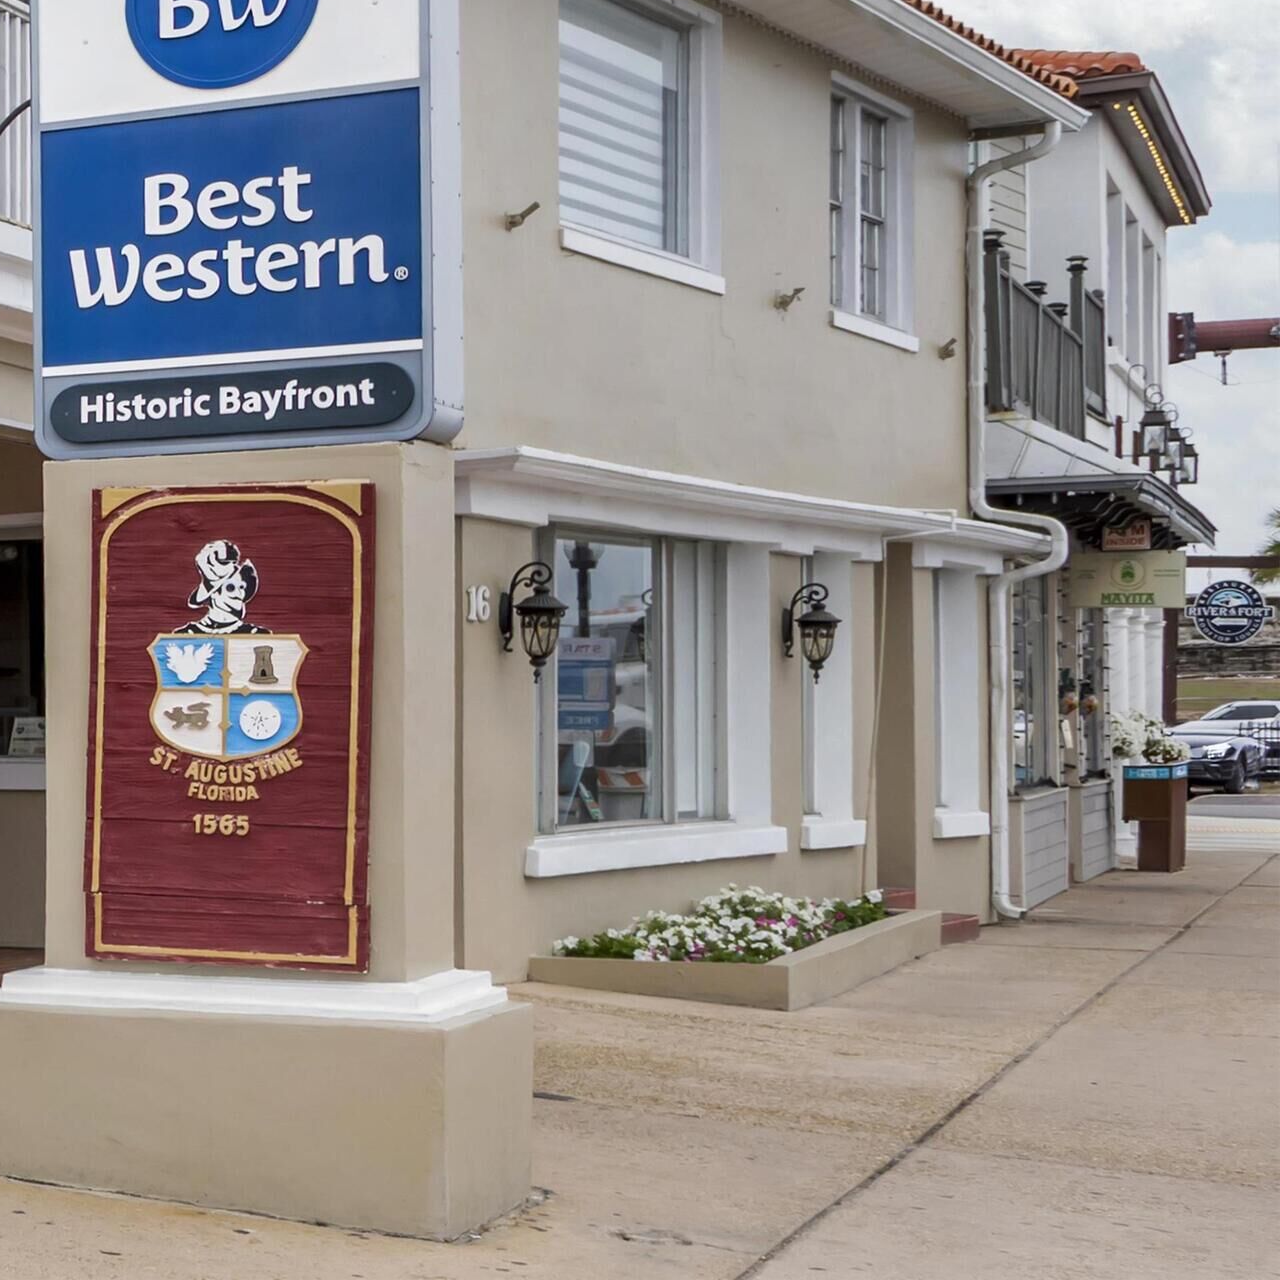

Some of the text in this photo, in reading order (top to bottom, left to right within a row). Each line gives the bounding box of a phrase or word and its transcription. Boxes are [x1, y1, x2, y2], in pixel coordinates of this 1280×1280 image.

[143, 166, 313, 236] Best
[80, 377, 375, 424] Historic Bayfront
[467, 585, 490, 622] 16
[1101, 592, 1155, 605] MAYITA
[149, 746, 304, 785] ST. AUGUSTINE
[188, 781, 260, 802] FLORIDA
[193, 813, 250, 837] 1565
